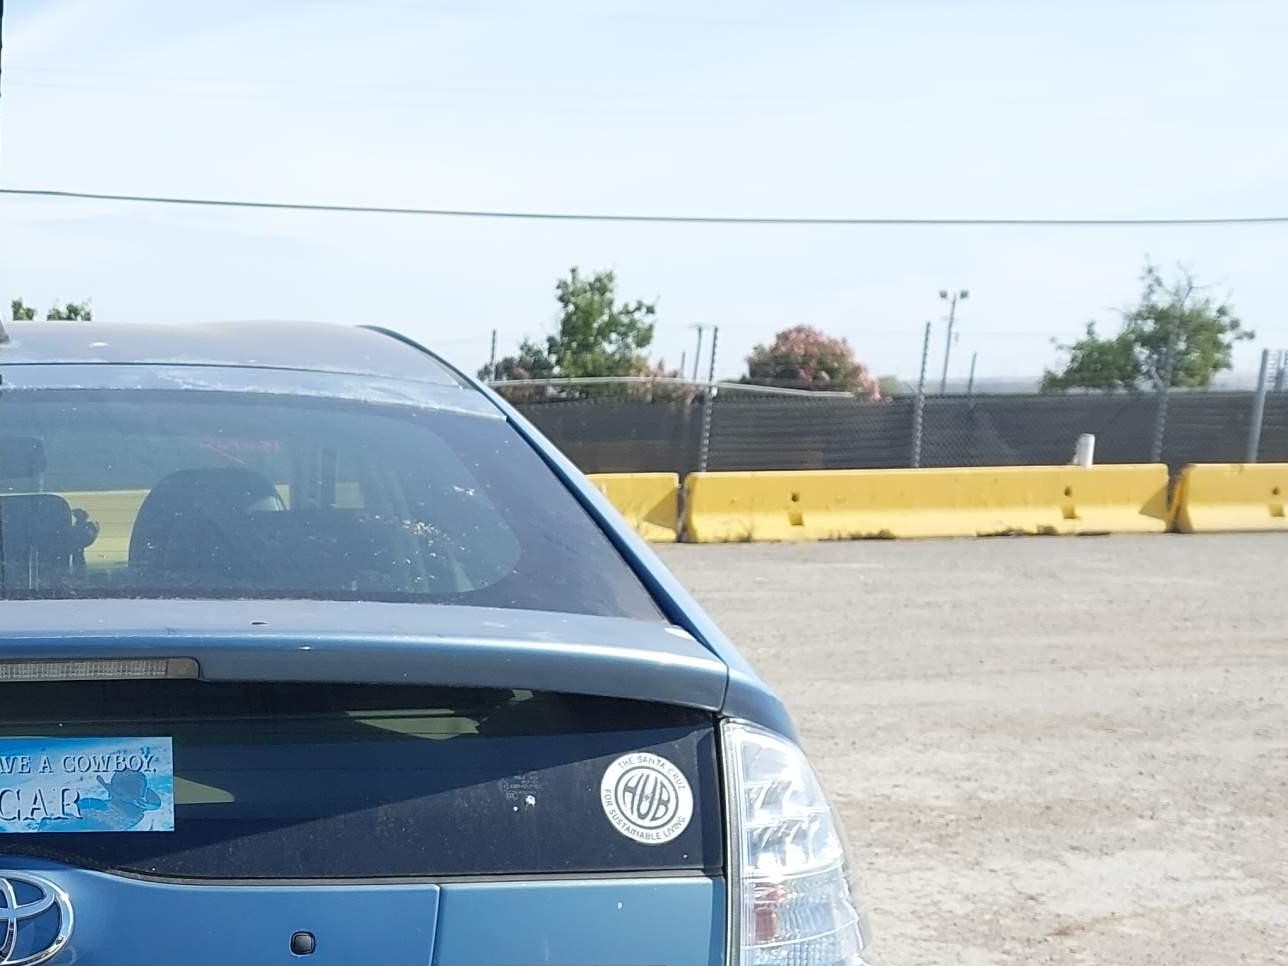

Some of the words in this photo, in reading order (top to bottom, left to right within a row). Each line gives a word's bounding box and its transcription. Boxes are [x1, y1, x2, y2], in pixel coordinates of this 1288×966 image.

[39, 755, 54, 774] A
[617, 757, 635, 769] THE
[635, 755, 667, 769] SANTA
[667, 768, 687, 790] CRUZ
[603, 788, 614, 808] FOR
[622, 772, 670, 822] HUB
[608, 809, 663, 841] SUSTAINABLE
